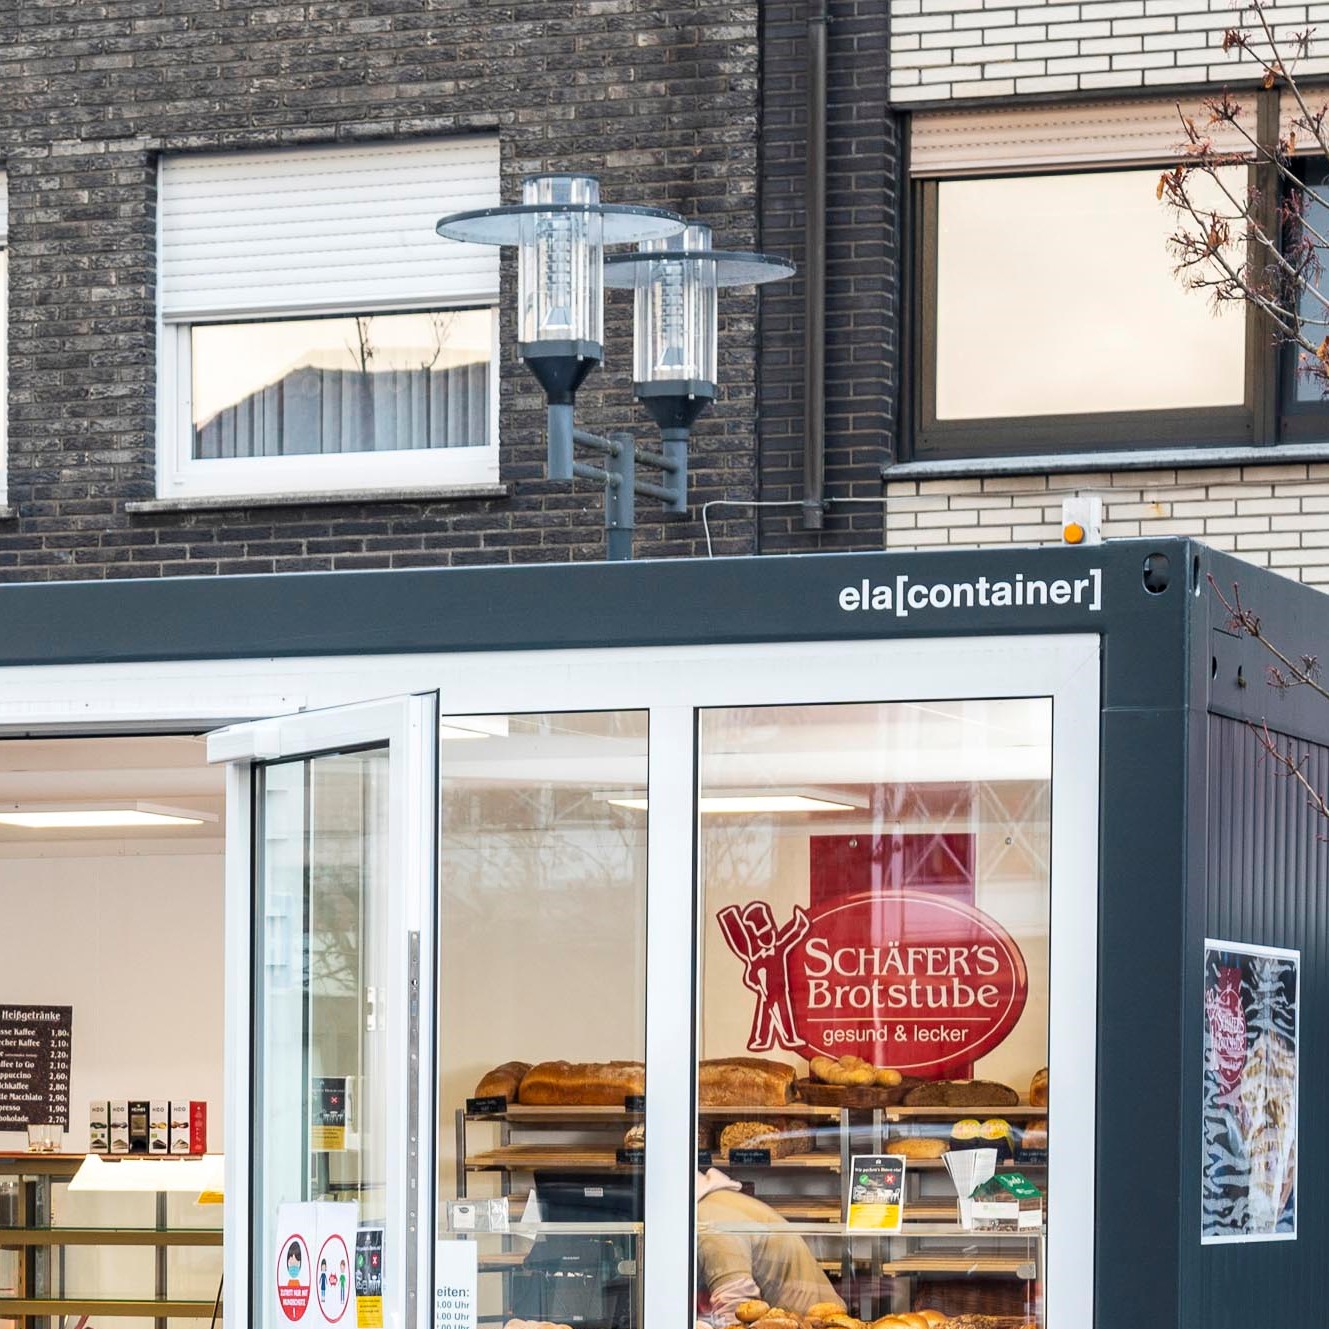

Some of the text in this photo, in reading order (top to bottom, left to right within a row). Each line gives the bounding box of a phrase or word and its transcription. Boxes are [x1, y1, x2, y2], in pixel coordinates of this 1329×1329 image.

[839, 569, 1101, 617] ela[container]
[803, 937, 1000, 977] SCHÄFER'S
[807, 978, 999, 1009] Brotstube
[14, 1028, 36, 1036] Kaffee
[823, 1025, 969, 1046] gesund & lecker
[18, 1039, 40, 1047] Kaffee
[9, 1093, 43, 1101] Macchiato
[454, 1301, 470, 1309] Uhr
[454, 1312, 470, 1321] Uhr
